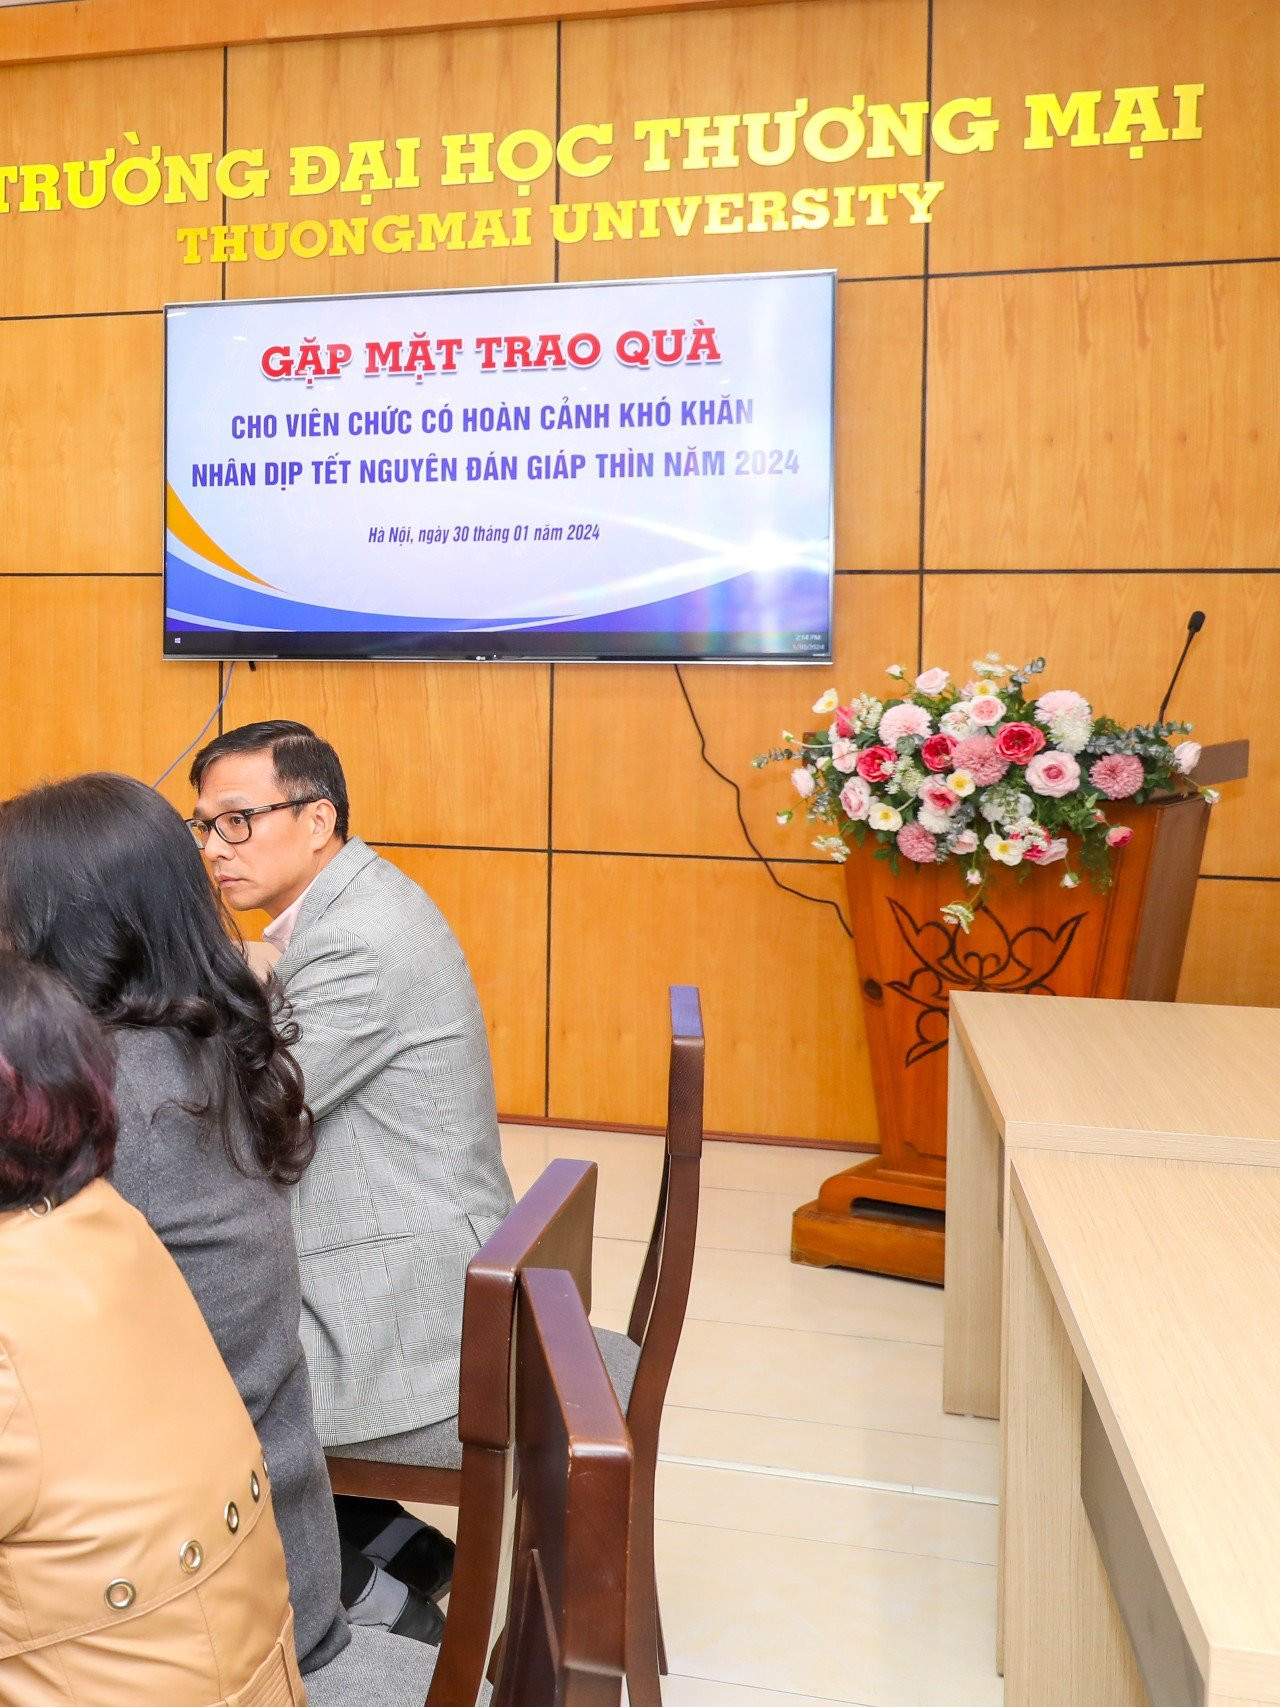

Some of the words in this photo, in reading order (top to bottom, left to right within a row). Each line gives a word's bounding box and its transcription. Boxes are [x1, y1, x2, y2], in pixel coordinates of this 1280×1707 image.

[289, 137, 421, 206] ĐẠI
[440, 123, 614, 197] HỌC
[633, 95, 1000, 172] THƯƠNG
[1023, 83, 1205, 160] MẠI
[176, 207, 532, 265] THUONGMAI
[549, 180, 945, 245] UNIVERSITY
[261, 337, 352, 386] GẶP
[365, 332, 463, 382] MẶT
[475, 332, 602, 370] TRAO
[615, 318, 721, 367] QUÀ
[231, 415, 278, 439] CHO
[286, 408, 339, 437] VIÊN
[348, 405, 412, 436] CHỨC
[421, 403, 453, 434] CÓ
[462, 401, 531, 432] HOÀN
[540, 396, 610, 431] CẢNH
[619, 396, 671, 428] KHÓ
[681, 394, 754, 426] KHĂN
[191, 458, 256, 488] NHÂN
[264, 461, 303, 491] DỊP
[311, 453, 351, 485] TẾT
[359, 453, 458, 484] NGUYÊN
[466, 451, 518, 481] ĐÁN
[527, 449, 586, 480] GIÁP
[595, 448, 654, 478] THÌN
[664, 446, 725, 477] NĂM
[734, 449, 800, 476] 2024
[368, 526, 385, 543] Hà
[388, 525, 414, 546] Nội,
[418, 526, 450, 545] ngày
[453, 526, 469, 542] 30
[473, 525, 510, 543] tháng
[513, 525, 529, 541] 01
[534, 523, 563, 541] năm
[567, 524, 600, 541] 2024
